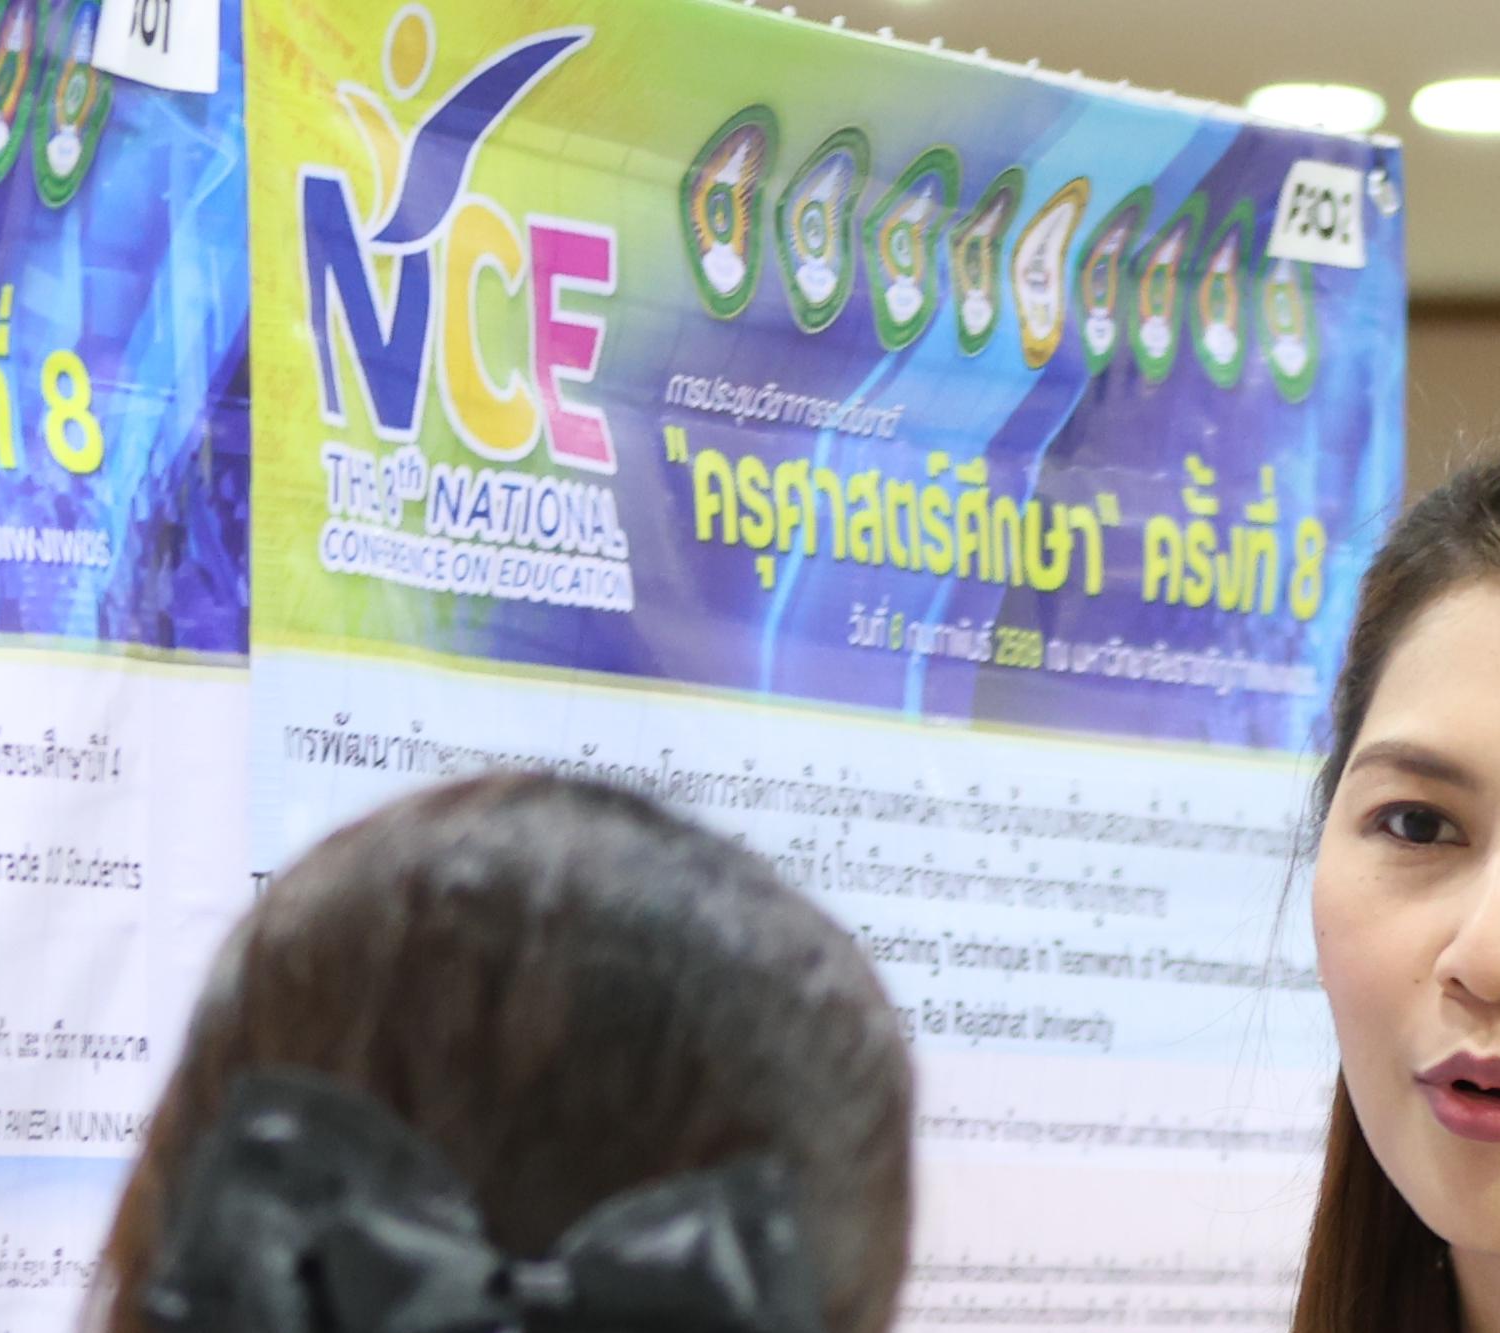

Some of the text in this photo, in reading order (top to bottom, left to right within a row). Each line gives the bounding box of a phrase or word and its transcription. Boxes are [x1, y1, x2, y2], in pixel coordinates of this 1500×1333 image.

[300, 163, 617, 474] NCE
[42, 349, 105, 475] 8
[326, 451, 627, 556] THE 8th NATIONAL
[1143, 455, 1280, 615] ครั้งที่
[1291, 517, 1326, 621] 8
[450, 548, 491, 587] ON
[498, 558, 631, 607] EDUCATION
